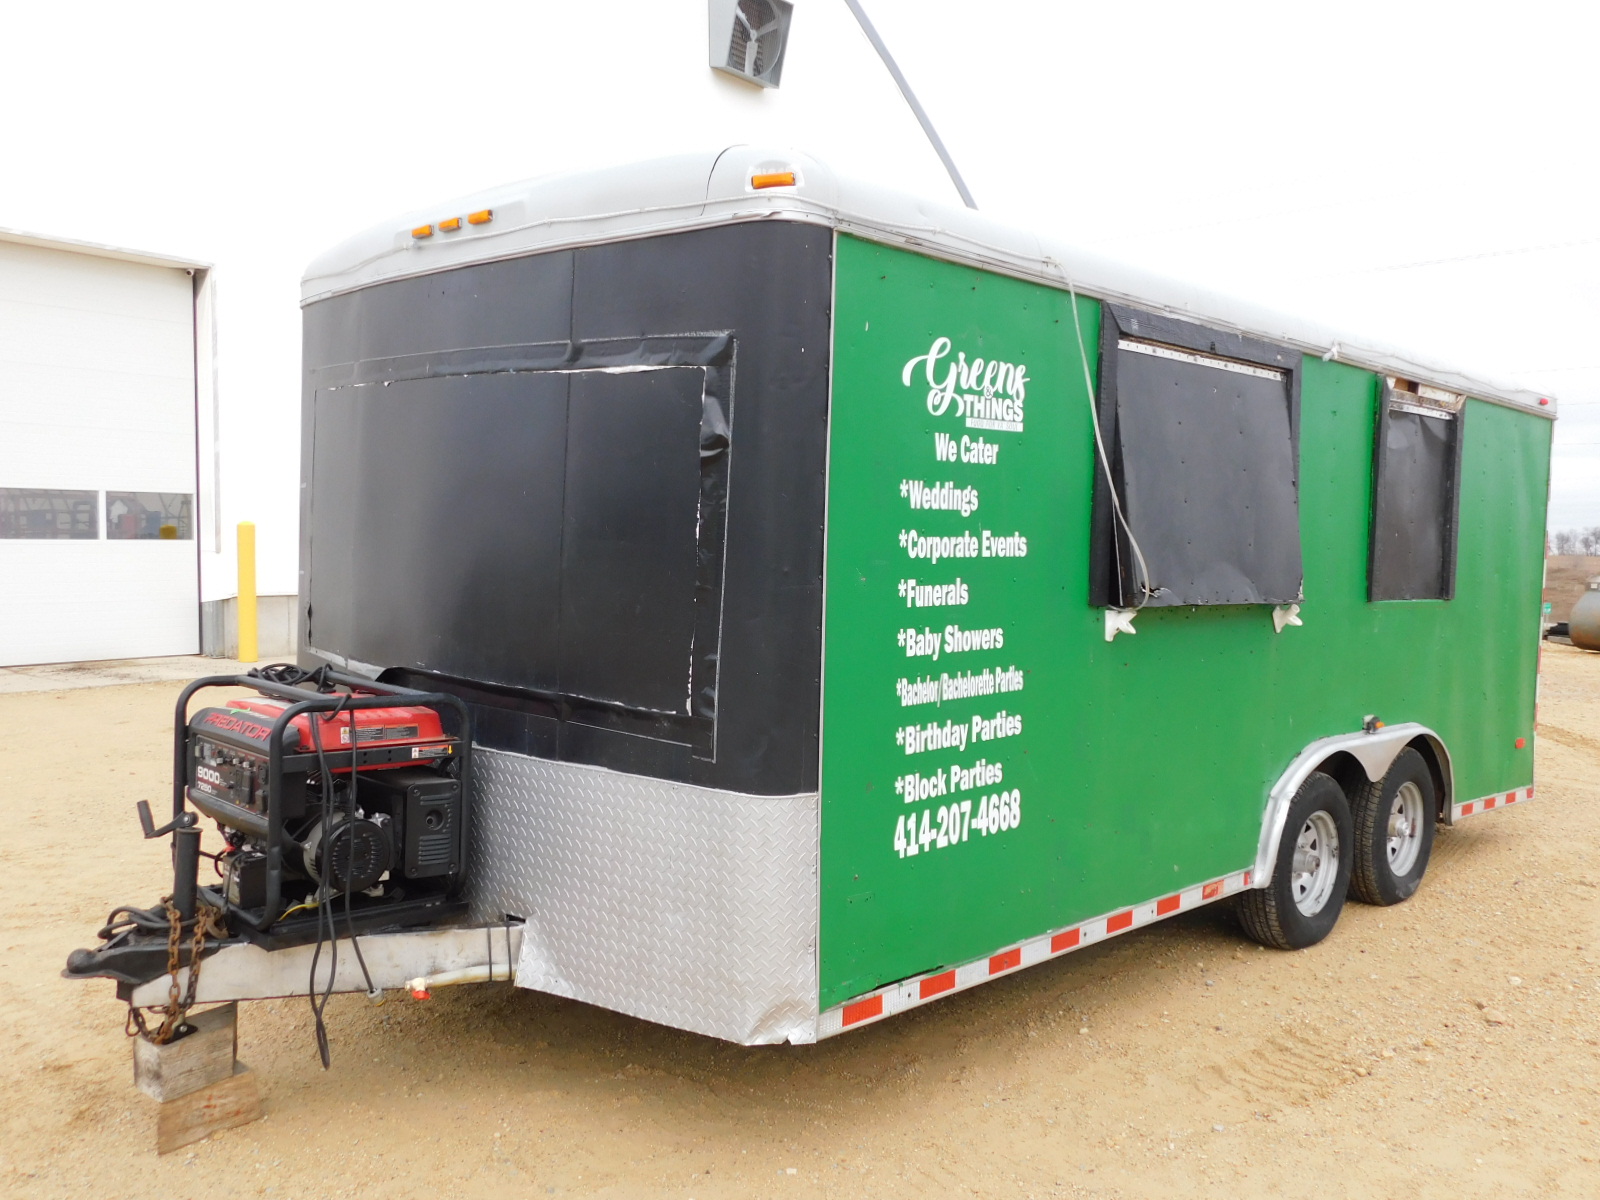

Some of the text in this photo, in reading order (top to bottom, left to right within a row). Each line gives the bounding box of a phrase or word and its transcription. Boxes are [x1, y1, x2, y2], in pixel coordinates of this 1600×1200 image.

[902, 337, 1030, 417] Greens
[935, 433, 999, 464] We Cater
[982, 530, 1027, 557] Events
[944, 625, 1003, 653] Showers
[995, 665, 1023, 693] Parties
[204, 712, 272, 741] PREDATOR
[972, 710, 1022, 742] Parties
[197, 766, 220, 784] 9000
[951, 758, 1002, 792] Parties
[894, 789, 1021, 859] 414-207-4668
